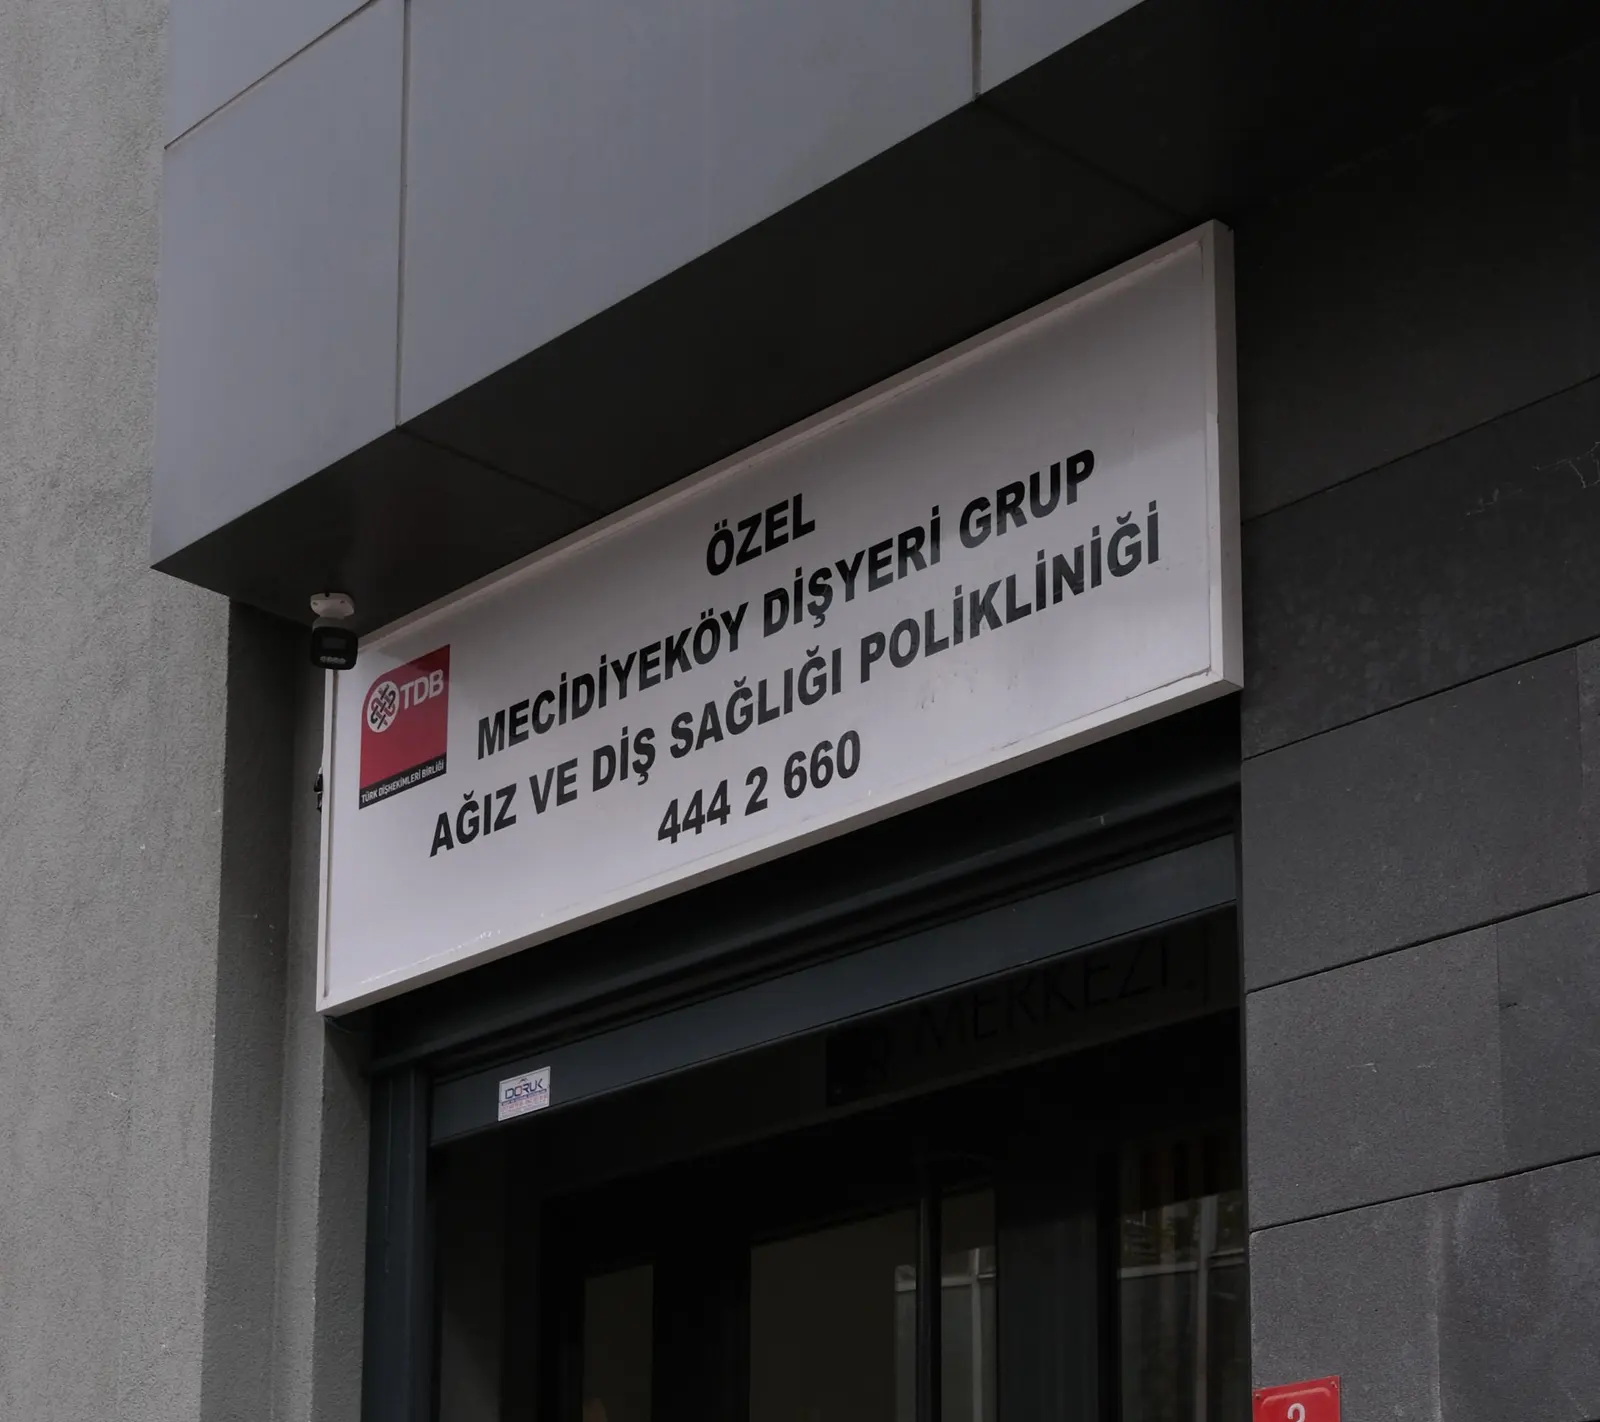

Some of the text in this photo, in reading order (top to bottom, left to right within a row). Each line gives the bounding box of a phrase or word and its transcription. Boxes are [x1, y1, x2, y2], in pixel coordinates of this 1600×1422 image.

[706, 493, 817, 577] ÖZEL
[477, 449, 1096, 761] MECİDİYEKÖY DİŞYERİ GRUP
[400, 669, 444, 711] TDB
[429, 500, 1160, 858] AĞIZ VE DİŞ SAĞLIĞI POLİKLİNİĞİ
[361, 790, 378, 804] TÜRK
[657, 729, 861, 845] 444 2 660
